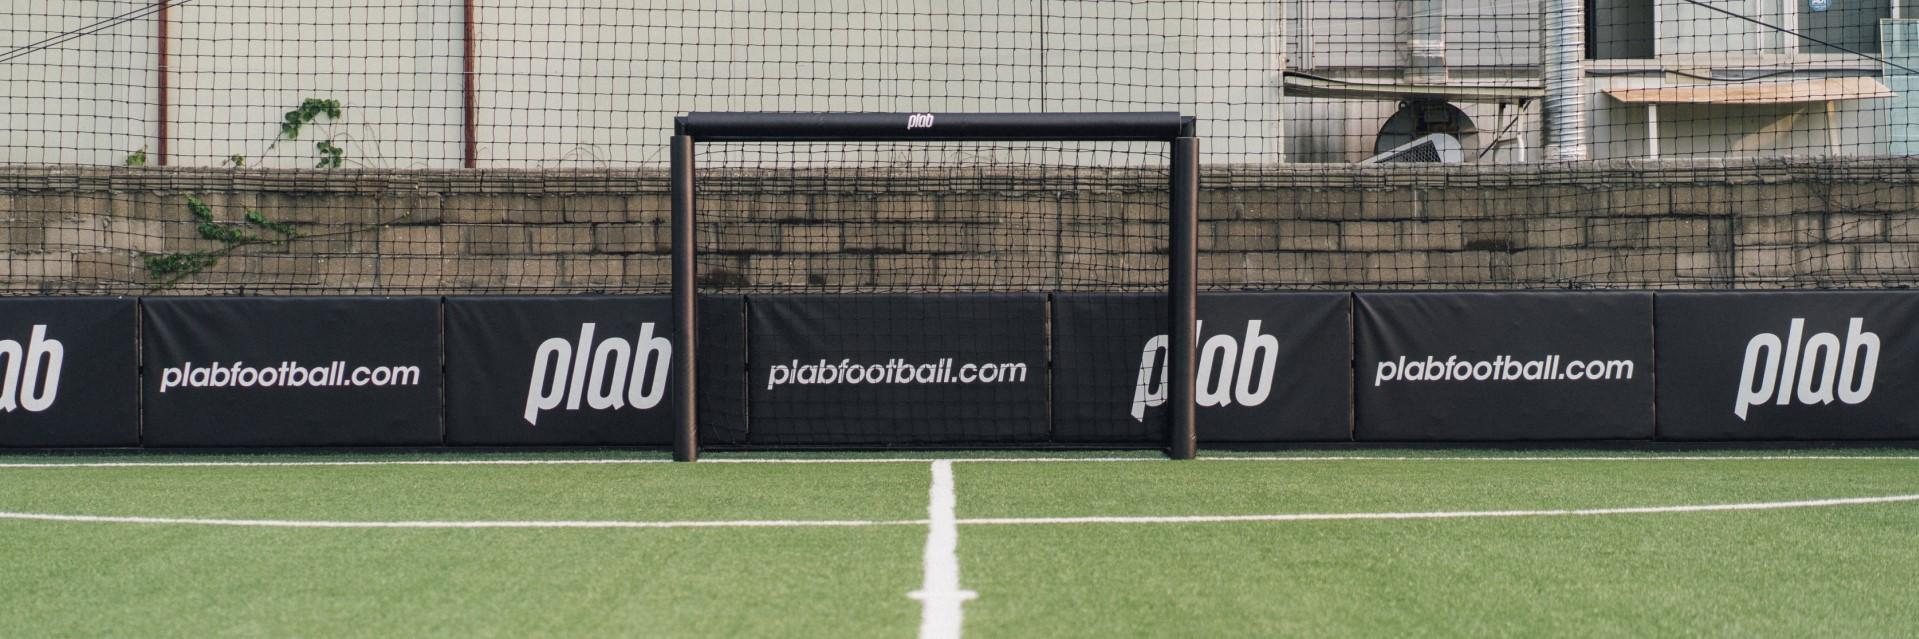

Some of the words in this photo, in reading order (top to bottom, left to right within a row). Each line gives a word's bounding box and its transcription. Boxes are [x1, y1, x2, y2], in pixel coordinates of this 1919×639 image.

[907, 113, 934, 130] plab
[160, 361, 420, 392] plabfootball.com
[524, 323, 672, 425] plab
[767, 358, 1027, 390] plabfootball.com
[1131, 320, 1278, 422] pab
[1375, 355, 1634, 386] plabfootball.com
[1735, 317, 1880, 421] plab
